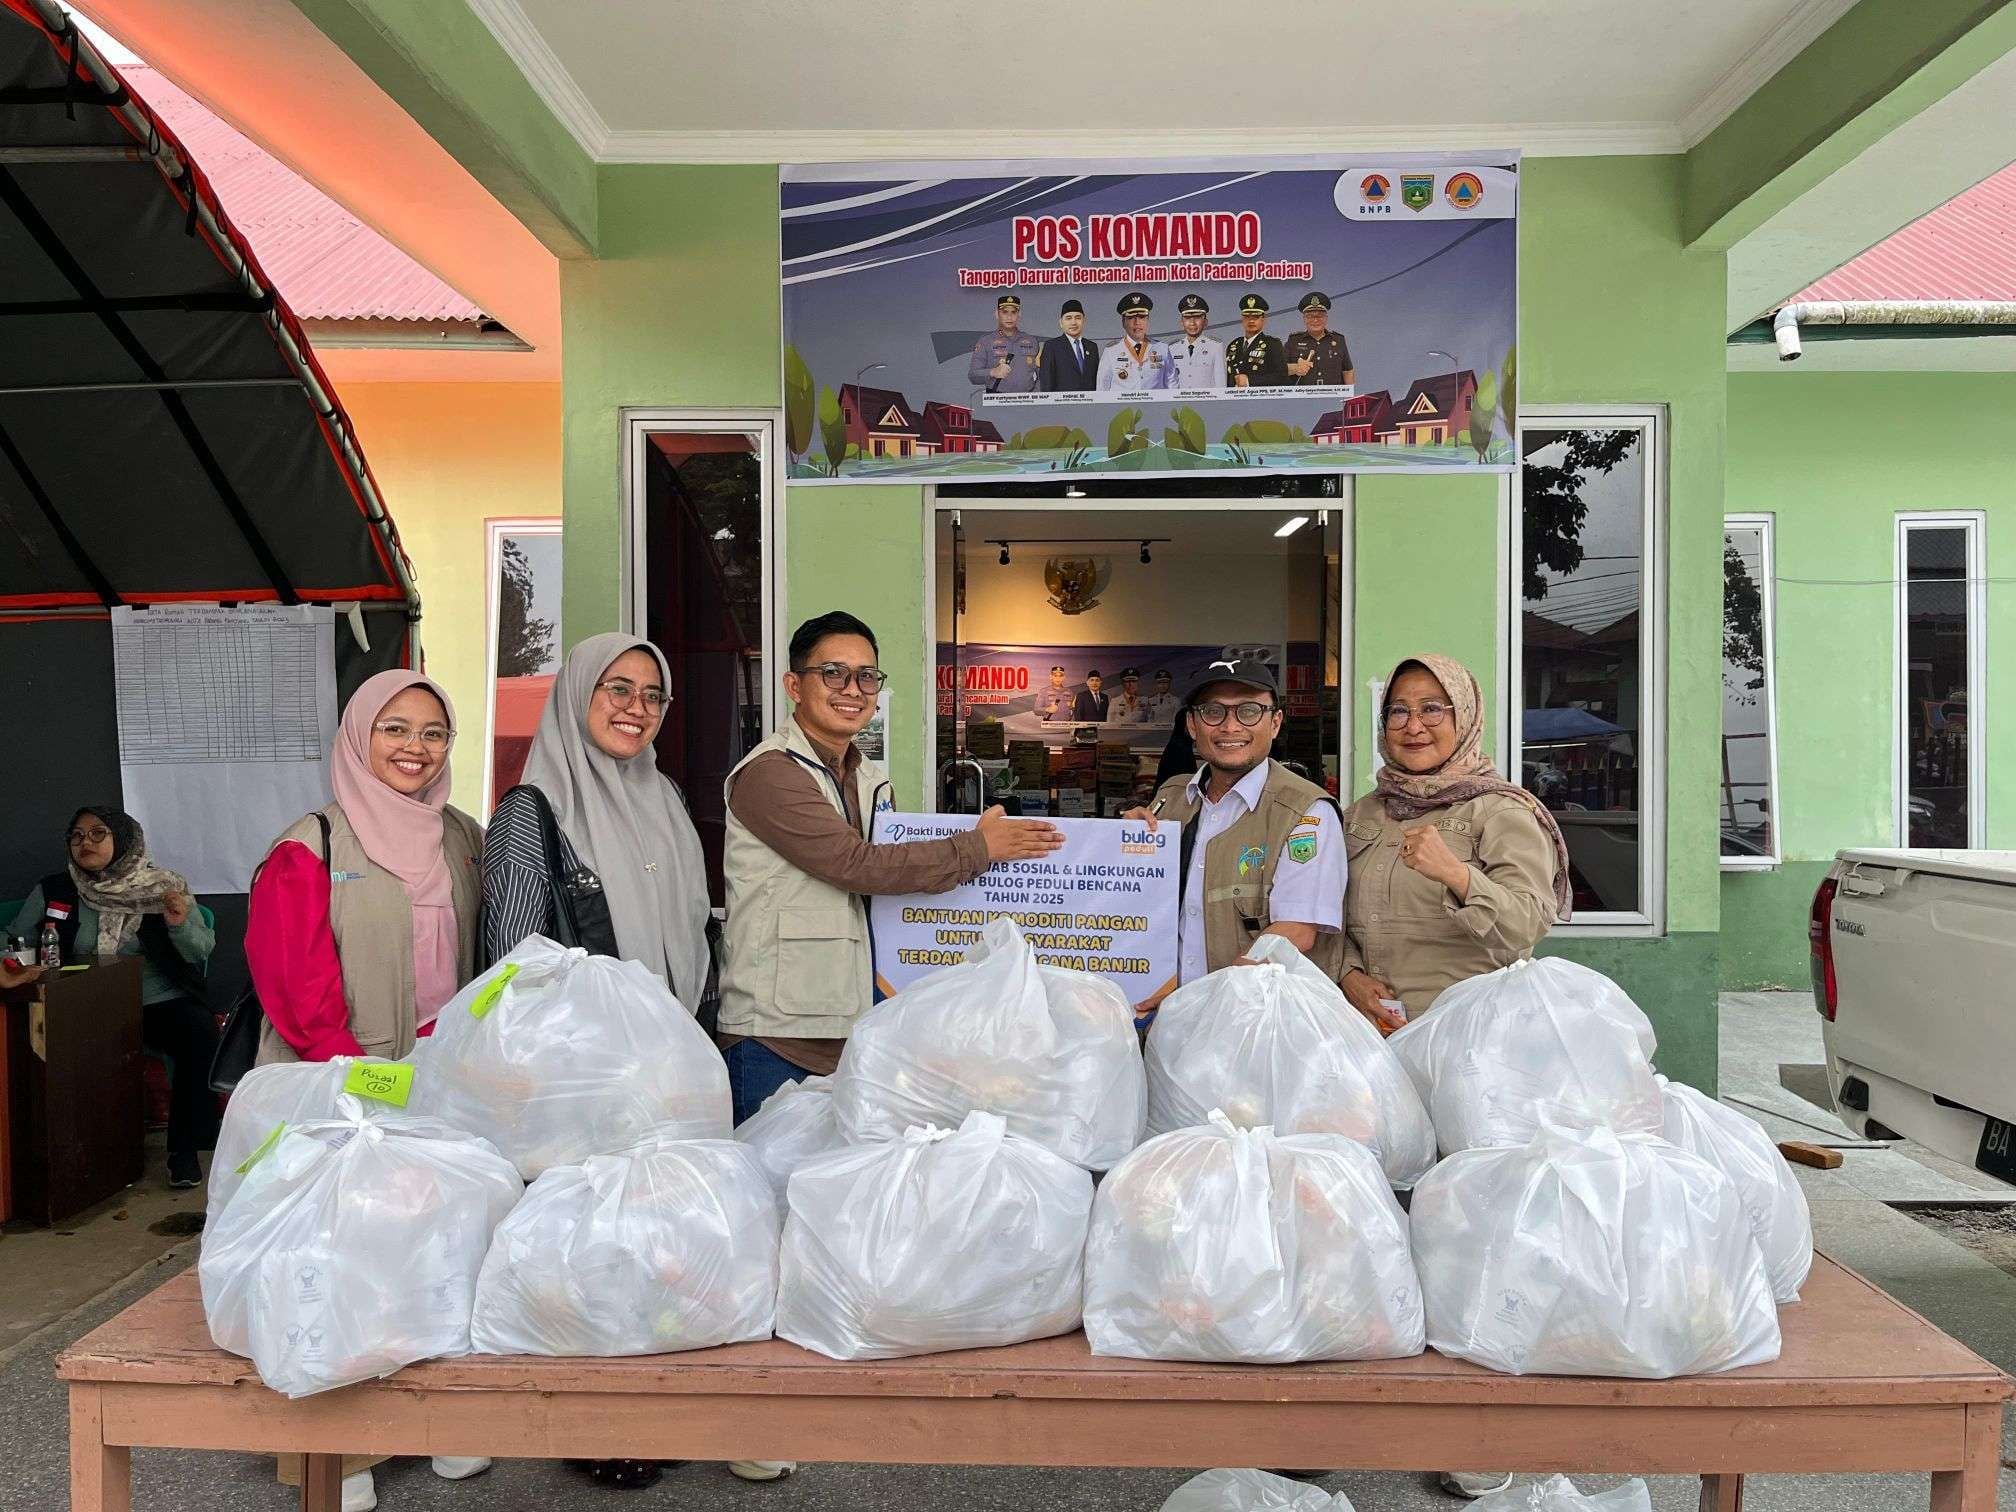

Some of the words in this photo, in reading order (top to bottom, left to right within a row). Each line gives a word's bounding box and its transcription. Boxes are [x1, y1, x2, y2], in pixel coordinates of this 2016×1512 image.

[1359, 205, 1392, 214] BNPB
[1015, 217, 1080, 261] POS
[1091, 213, 1260, 259] KOMANDO
[959, 269, 1016, 287] Tanggap
[1019, 267, 1069, 285] Darurat
[1073, 266, 1130, 283] Bencana
[1134, 265, 1167, 282] Alam
[1170, 264, 1200, 281] Kota
[1203, 262, 1254, 281] Padang
[1257, 261, 1312, 280] Panjang
[906, 826, 933, 836] Bakti
[1122, 830, 1166, 848] bulog
[1013, 862, 1059, 875] SOSIAL
[1062, 864, 1072, 875] &
[1075, 865, 1165, 878] LINGKUNGAN
[978, 876, 1024, 889] BULOG
[1027, 878, 1074, 890] PEDULI
[1077, 880, 1142, 893] BENCANA
[984, 891, 1029, 903] TAHUN
[1033, 892, 1064, 905] 2025
[902, 908, 984, 925] BANTUAN
[1075, 915, 1148, 932] PANGAN
[1835, 918, 1867, 938] TOYOTA
[935, 930, 985, 945] UNTU
[1023, 933, 1112, 950] SYARAKAT
[1087, 956, 1150, 974] BANJIR
[1986, 1120, 2011, 1157] BA
